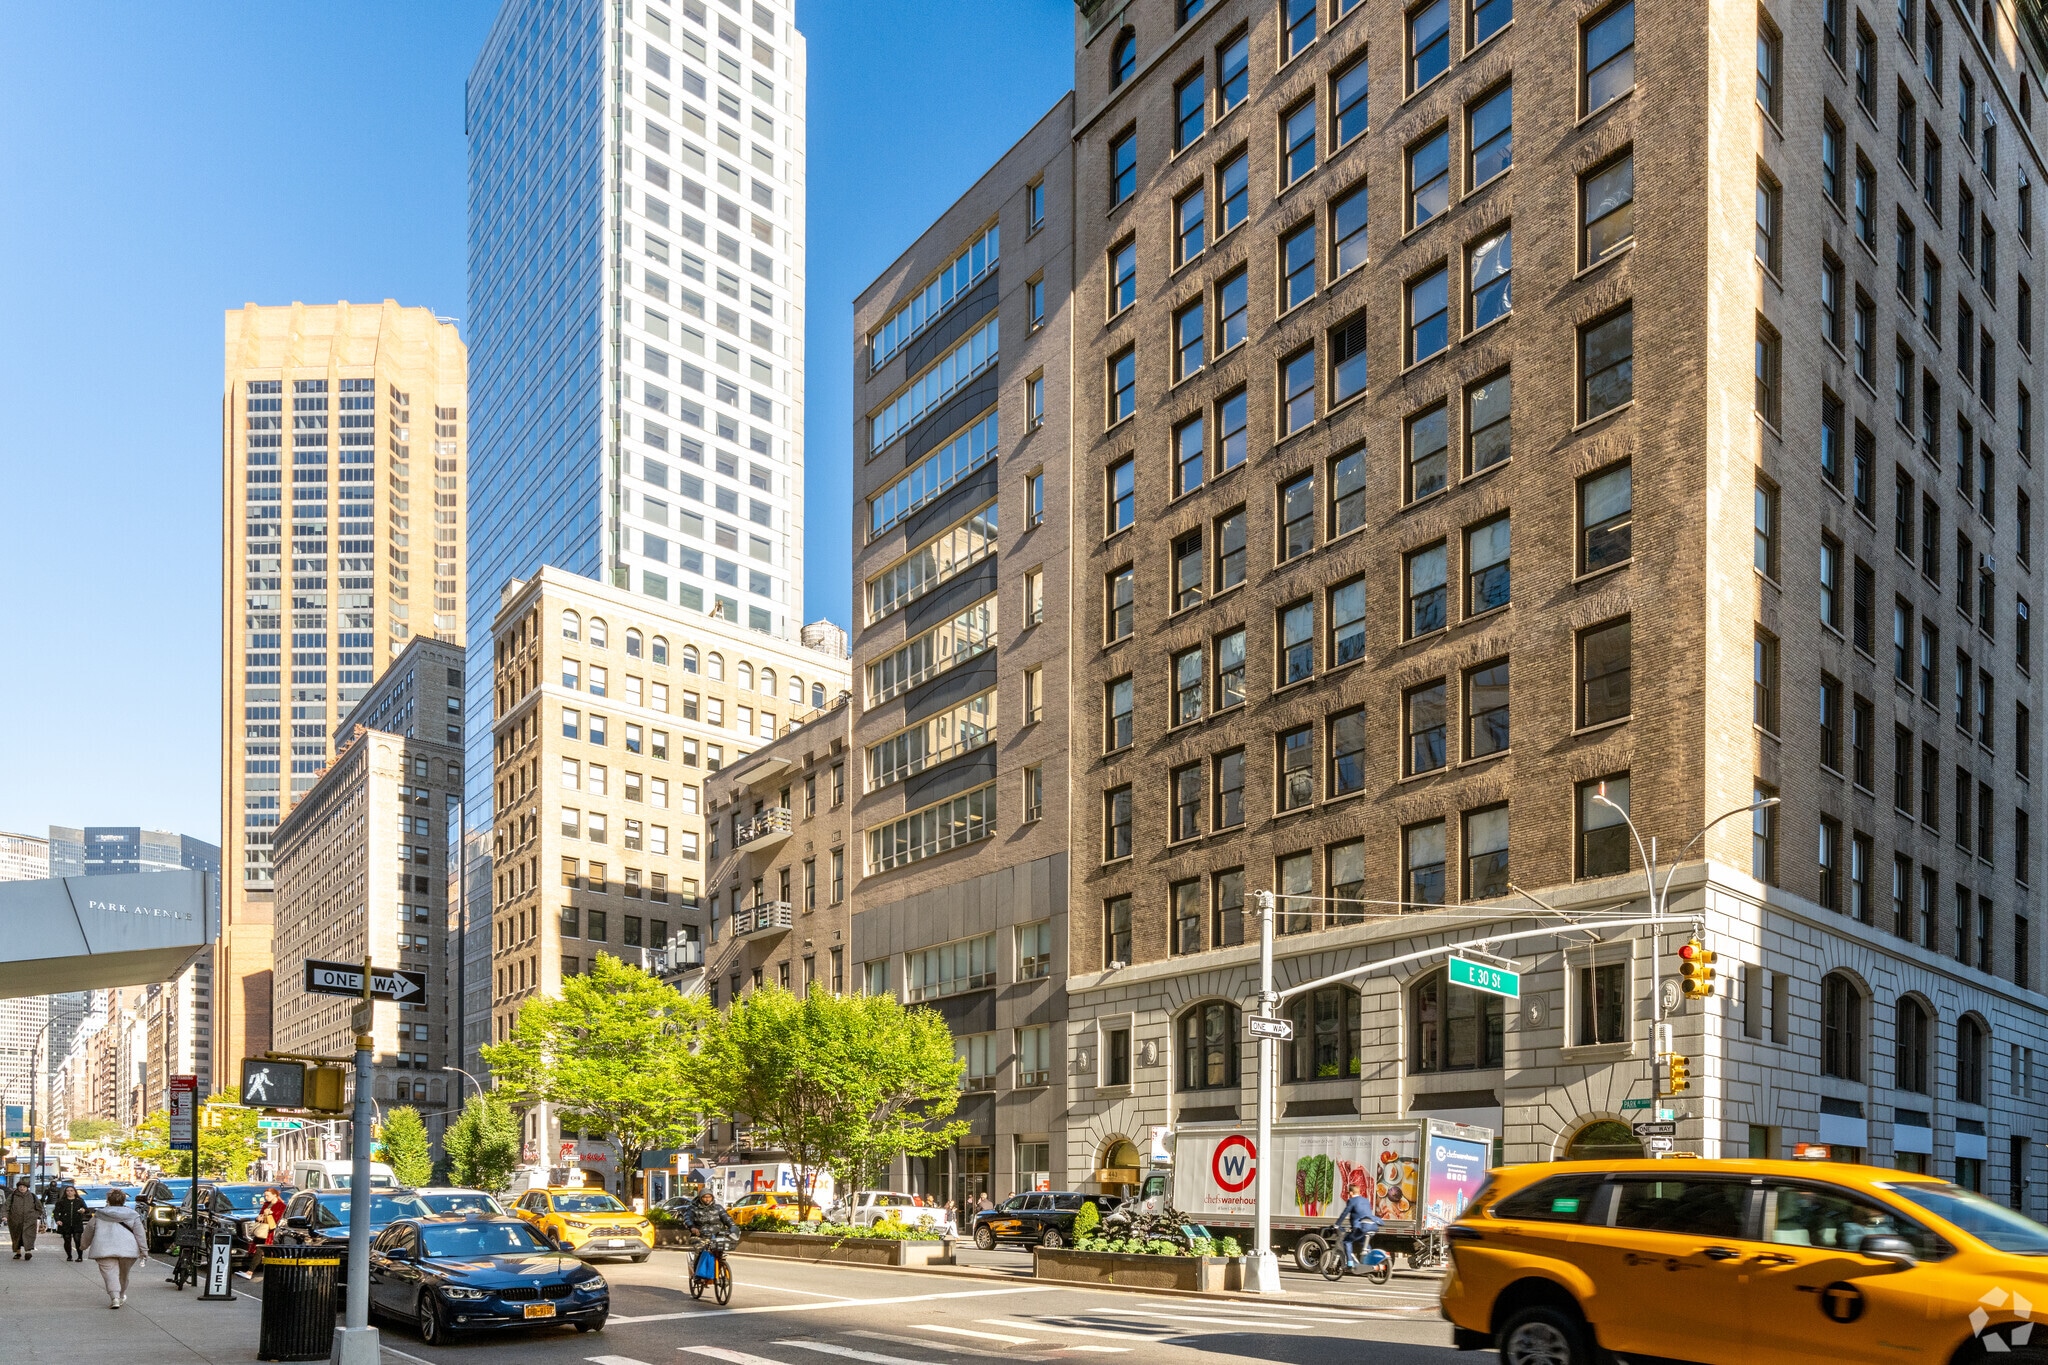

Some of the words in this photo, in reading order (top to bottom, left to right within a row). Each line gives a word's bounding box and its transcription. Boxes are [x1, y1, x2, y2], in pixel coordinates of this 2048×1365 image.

[88, 900, 128, 913] PARK
[134, 906, 193, 921] AVENUE
[323, 971, 358, 988] ONE
[373, 977, 408, 993] WAY
[1469, 966, 1475, 983] E
[1477, 968, 1490, 986] 30
[1491, 972, 1501, 989] St
[1252, 1021, 1267, 1031] ONE
[1272, 1024, 1287, 1034] WAY
[1623, 1100, 1637, 1109] PARK
[214, 1246, 226, 1293] VALET
